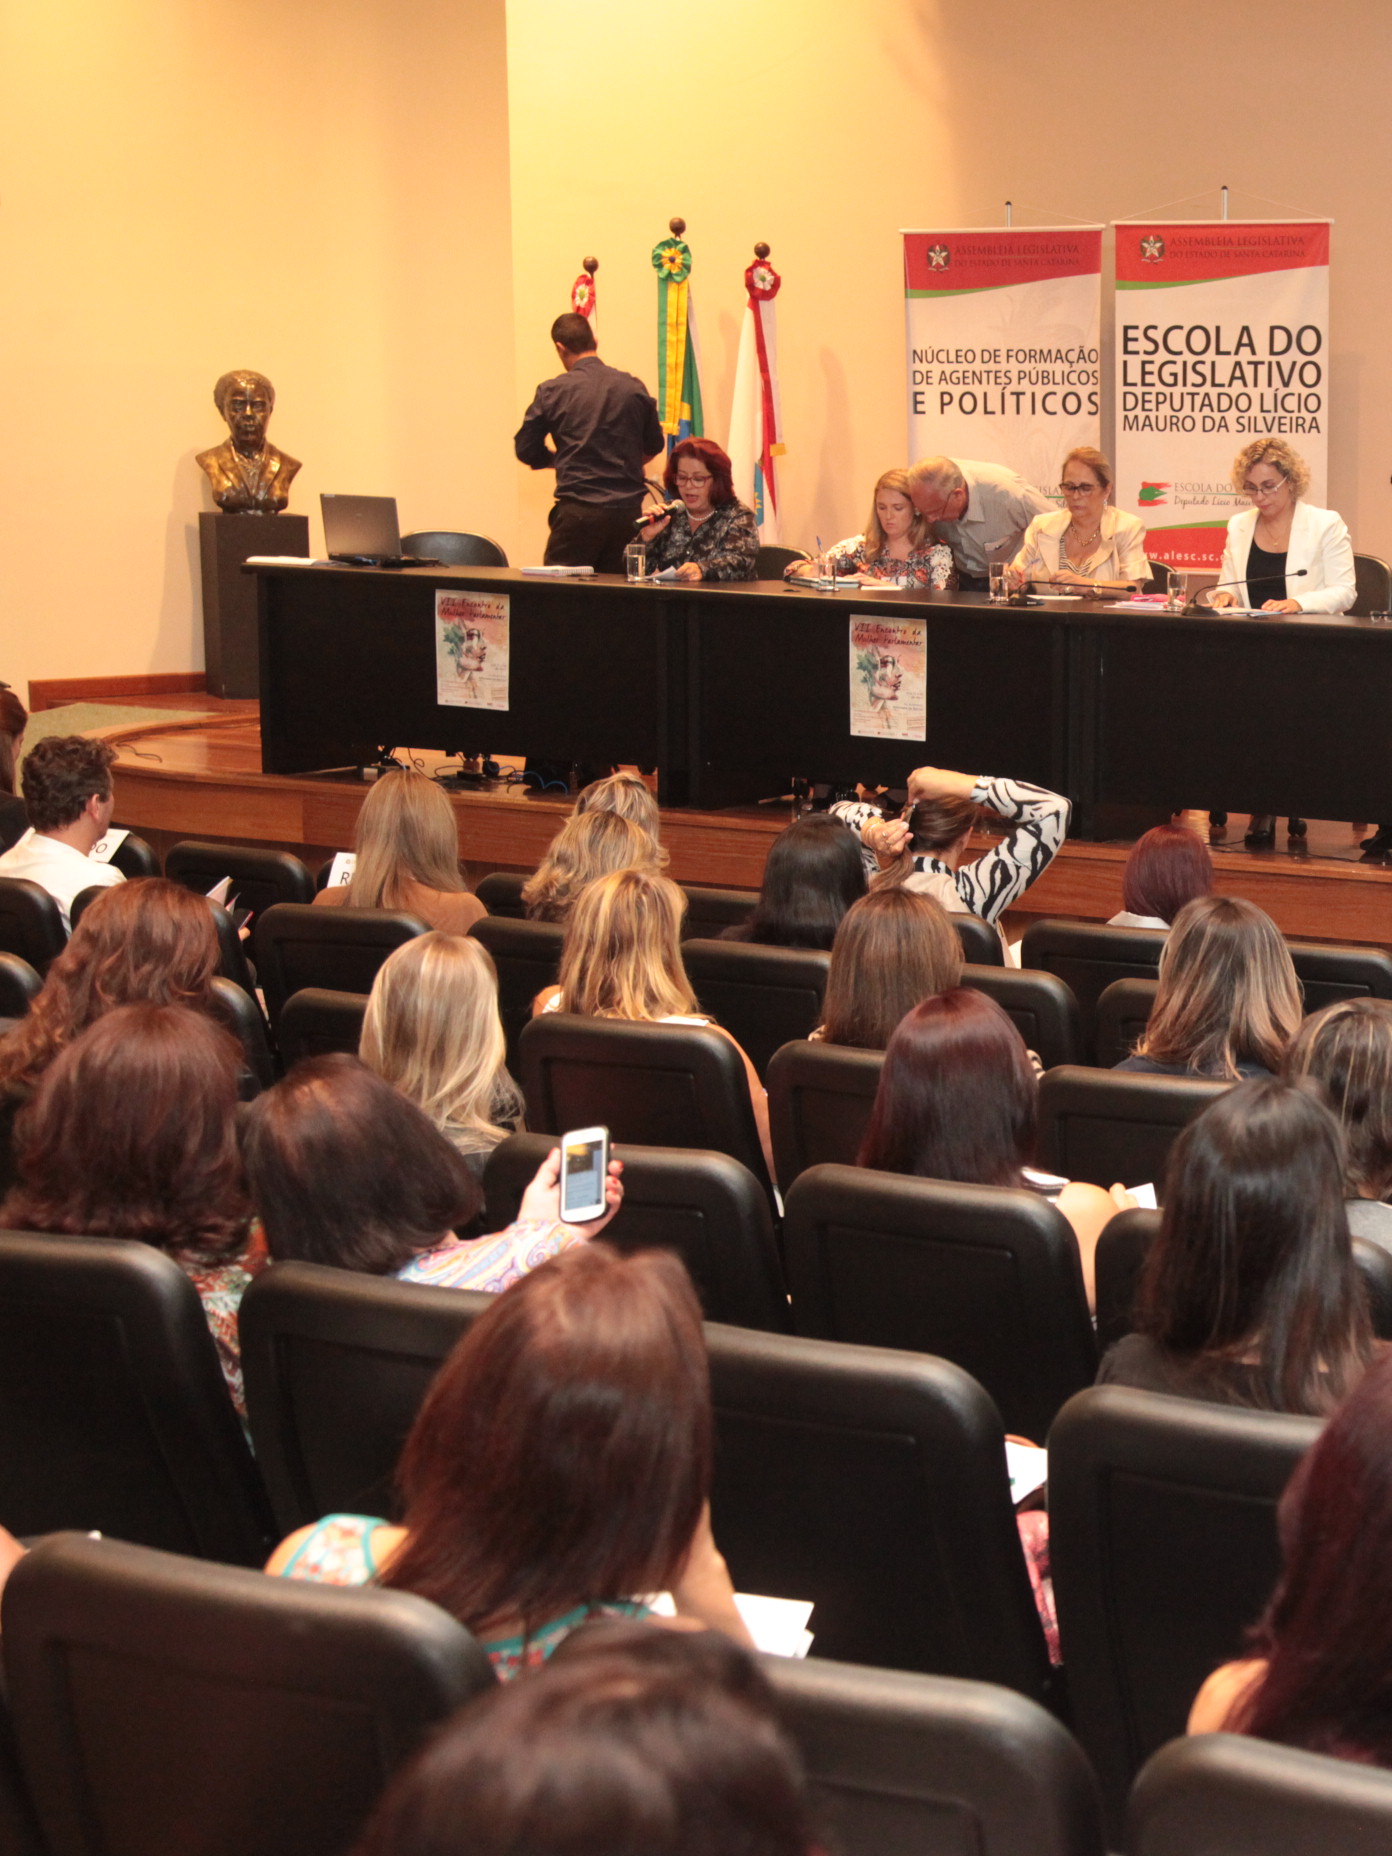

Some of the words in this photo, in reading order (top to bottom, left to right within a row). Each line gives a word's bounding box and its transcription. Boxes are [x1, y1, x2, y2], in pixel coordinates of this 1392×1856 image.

[955, 245, 1014, 255] ASSEMBLEIA
[1017, 244, 1080, 254] LEGISLATIVA
[1170, 237, 1233, 246] ASSEMBLEIA
[1237, 235, 1305, 245] LEGISLATIVA
[1122, 325, 1257, 356] ESCOLA
[1268, 325, 1322, 356] DO
[912, 346, 976, 364] NÚCLEO
[981, 349, 1001, 364] DE
[1006, 346, 1099, 368] FORMAÇÃO
[912, 370, 934, 386] DE
[938, 370, 1012, 386] AGENTES
[1017, 367, 1099, 386] PÚBLICOS
[1122, 360, 1322, 388] LEGISLATIVO
[912, 391, 926, 415] E
[940, 386, 1099, 416] POLÍTICOS
[1122, 391, 1252, 413] DEPUTADO
[1260, 388, 1322, 414] LÍCIO
[1123, 414, 1196, 433] MAURO
[1202, 415, 1230, 433] DA
[1235, 416, 1321, 434] SILVEIRA
[1174, 482, 1213, 492] ESCOLA
[1216, 482, 1233, 493] DO
[1174, 495, 1210, 510] Deputado
